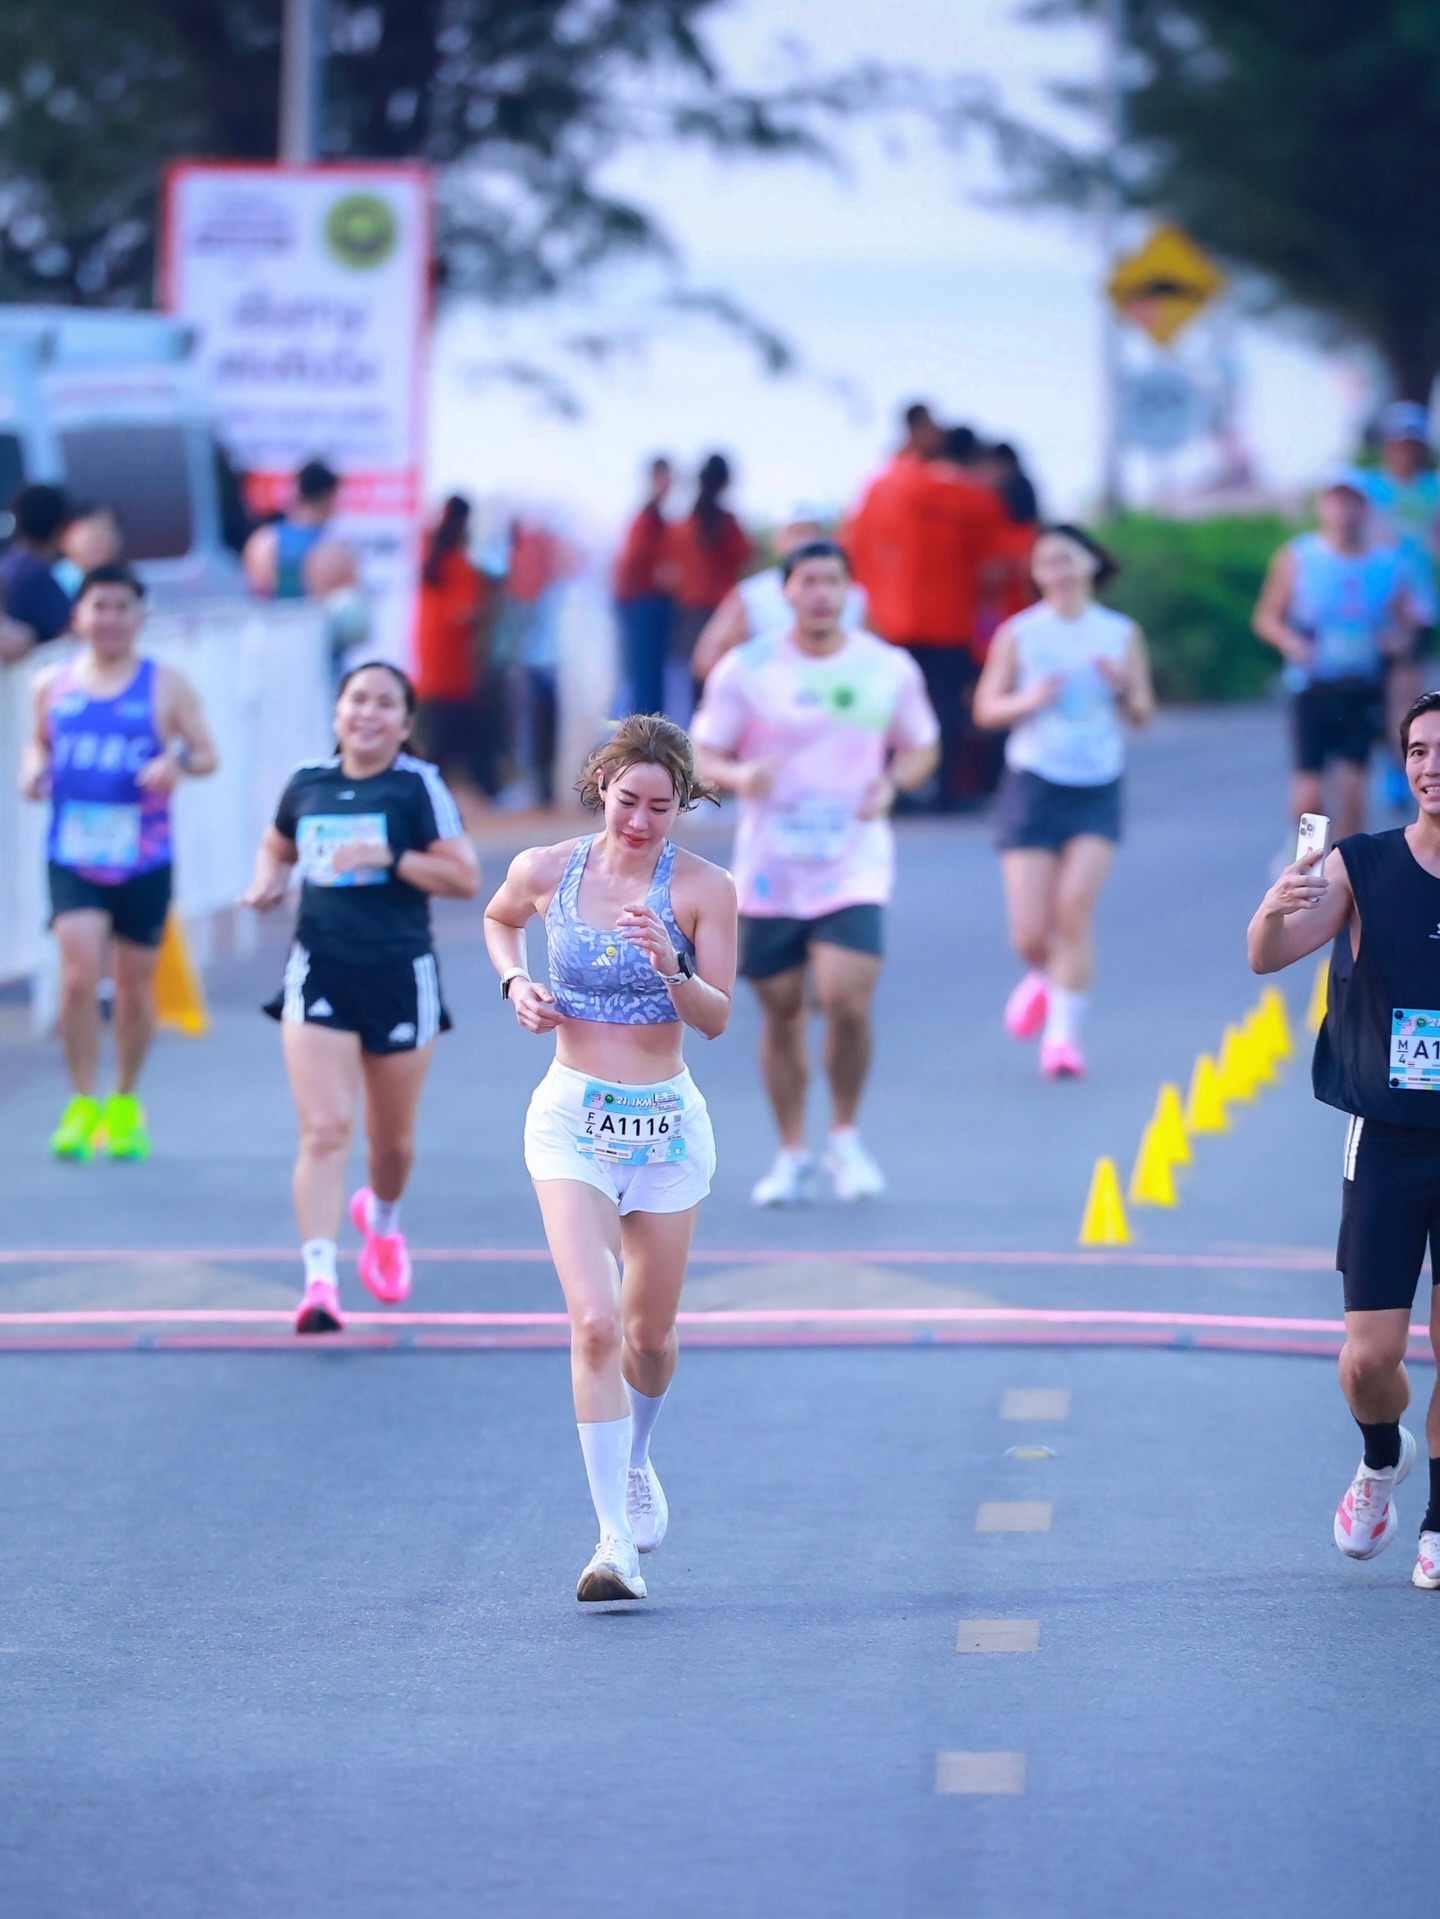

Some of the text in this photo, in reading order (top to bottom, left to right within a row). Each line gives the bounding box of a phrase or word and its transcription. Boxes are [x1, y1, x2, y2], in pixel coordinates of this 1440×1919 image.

[1398, 1040, 1408, 1050] M
[1398, 1053, 1406, 1064] 4
[587, 1112, 596, 1122] F
[586, 1125, 594, 1136] 4
[600, 1114, 670, 1137] A1116
